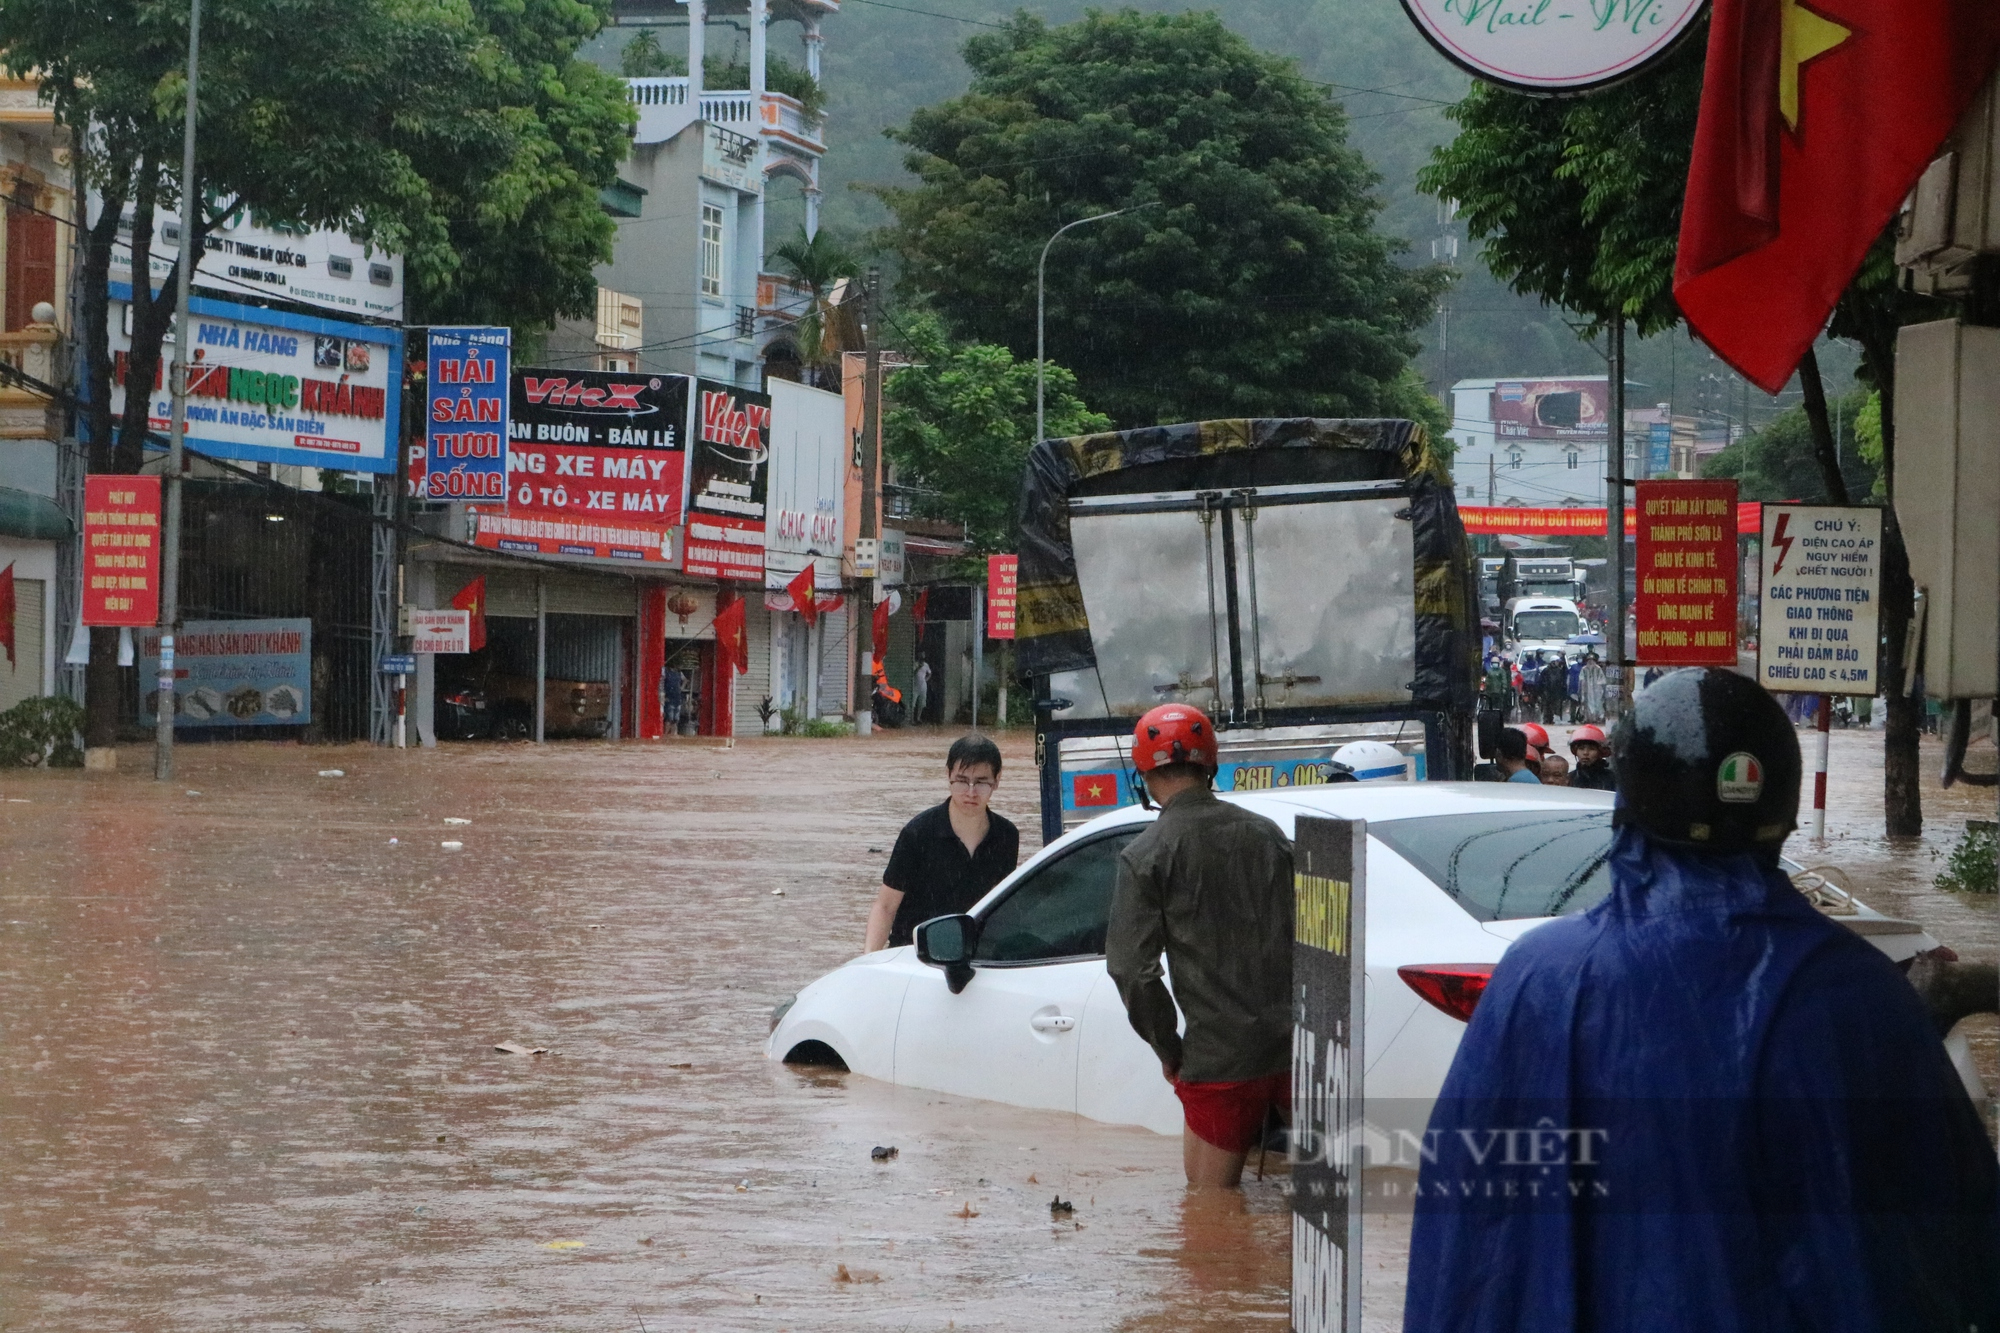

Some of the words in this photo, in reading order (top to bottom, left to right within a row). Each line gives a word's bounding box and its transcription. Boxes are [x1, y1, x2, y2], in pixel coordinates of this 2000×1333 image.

[197, 322, 240, 349] NHÀ
[243, 327, 299, 357] HÀNG
[432, 333, 461, 346] Nhà
[468, 333, 505, 346] hàng
[439, 348, 496, 384] HẢI
[186, 348, 229, 399] ẢN
[229, 366, 299, 415] NGỌC
[301, 373, 385, 421] KHÁNH
[432, 388, 501, 423] SẢN
[186, 404, 217, 422] MÓN
[220, 407, 240, 426] ĂN
[240, 411, 266, 430] ĐẶC
[268, 411, 294, 432] SẢN
[296, 412, 325, 435] BIỂN
[433, 431, 500, 458] TƯƠI
[537, 421, 590, 443] BUÔN
[608, 424, 648, 446] BÁN
[653, 424, 675, 447] LẺ
[555, 455, 595, 477] XE
[603, 455, 667, 481] MÁY
[429, 462, 504, 497] SỐNG
[518, 482, 533, 505] Ô
[539, 484, 568, 507] TÔ
[586, 490, 616, 510] XE
[622, 489, 670, 512] MÁY
[1645, 495, 1669, 516] QUYẾT
[1671, 496, 1688, 515] TÂM
[1689, 496, 1704, 515] XÂY
[1706, 499, 1728, 518] DỰNG
[780, 510, 805, 539] CHIC
[813, 514, 837, 543] CHIC
[1485, 510, 1520, 527] CHÍNH
[1522, 508, 1545, 527] PHỦ
[1548, 508, 1567, 527] ĐỐI
[1570, 512, 1601, 530] THOẠI
[1814, 518, 1843, 532] CHÚ
[1650, 522, 1676, 541] THÀNH
[1677, 521, 1693, 541] PHỐ
[1695, 524, 1711, 541] SƠN
[1712, 526, 1723, 541] LA
[1802, 536, 1828, 550] ĐIỆN
[1831, 539, 1855, 549] CAO
[1858, 536, 1874, 549] ÁP
[1654, 549, 1673, 567] GIÀU
[1685, 552, 1704, 567] KINH
[1806, 552, 1838, 562] NGUY
[1841, 549, 1868, 562] HIỂM
[1800, 563, 1828, 576] CHẾT
[1831, 564, 1867, 576] NGƯỜI
[1656, 578, 1675, 597] ĐỊNH
[1688, 575, 1712, 594] CHÍNH
[1770, 584, 1792, 599] CÁC
[1796, 586, 1841, 601] PHƯƠNG
[1845, 586, 1870, 605] TIỆN
[1679, 604, 1703, 624] MẠNH
[1786, 606, 1812, 620] GIAO
[1817, 605, 1853, 621] THÔNG
[1639, 625, 1659, 648] QUỐC
[1661, 627, 1687, 647] PHÒNG
[1694, 631, 1706, 647] AN
[1707, 631, 1727, 647] NINH
[1789, 626, 1807, 640] KHI
[1811, 627, 1822, 640] ĐI
[1826, 628, 1848, 642] QUA
[1778, 641, 1804, 659] PHẢI
[1807, 643, 1833, 660] ĐẢM
[1836, 643, 1858, 661] BẢO
[1804, 667, 1826, 680] CAO
[1840, 668, 1868, 682] 4,5M
